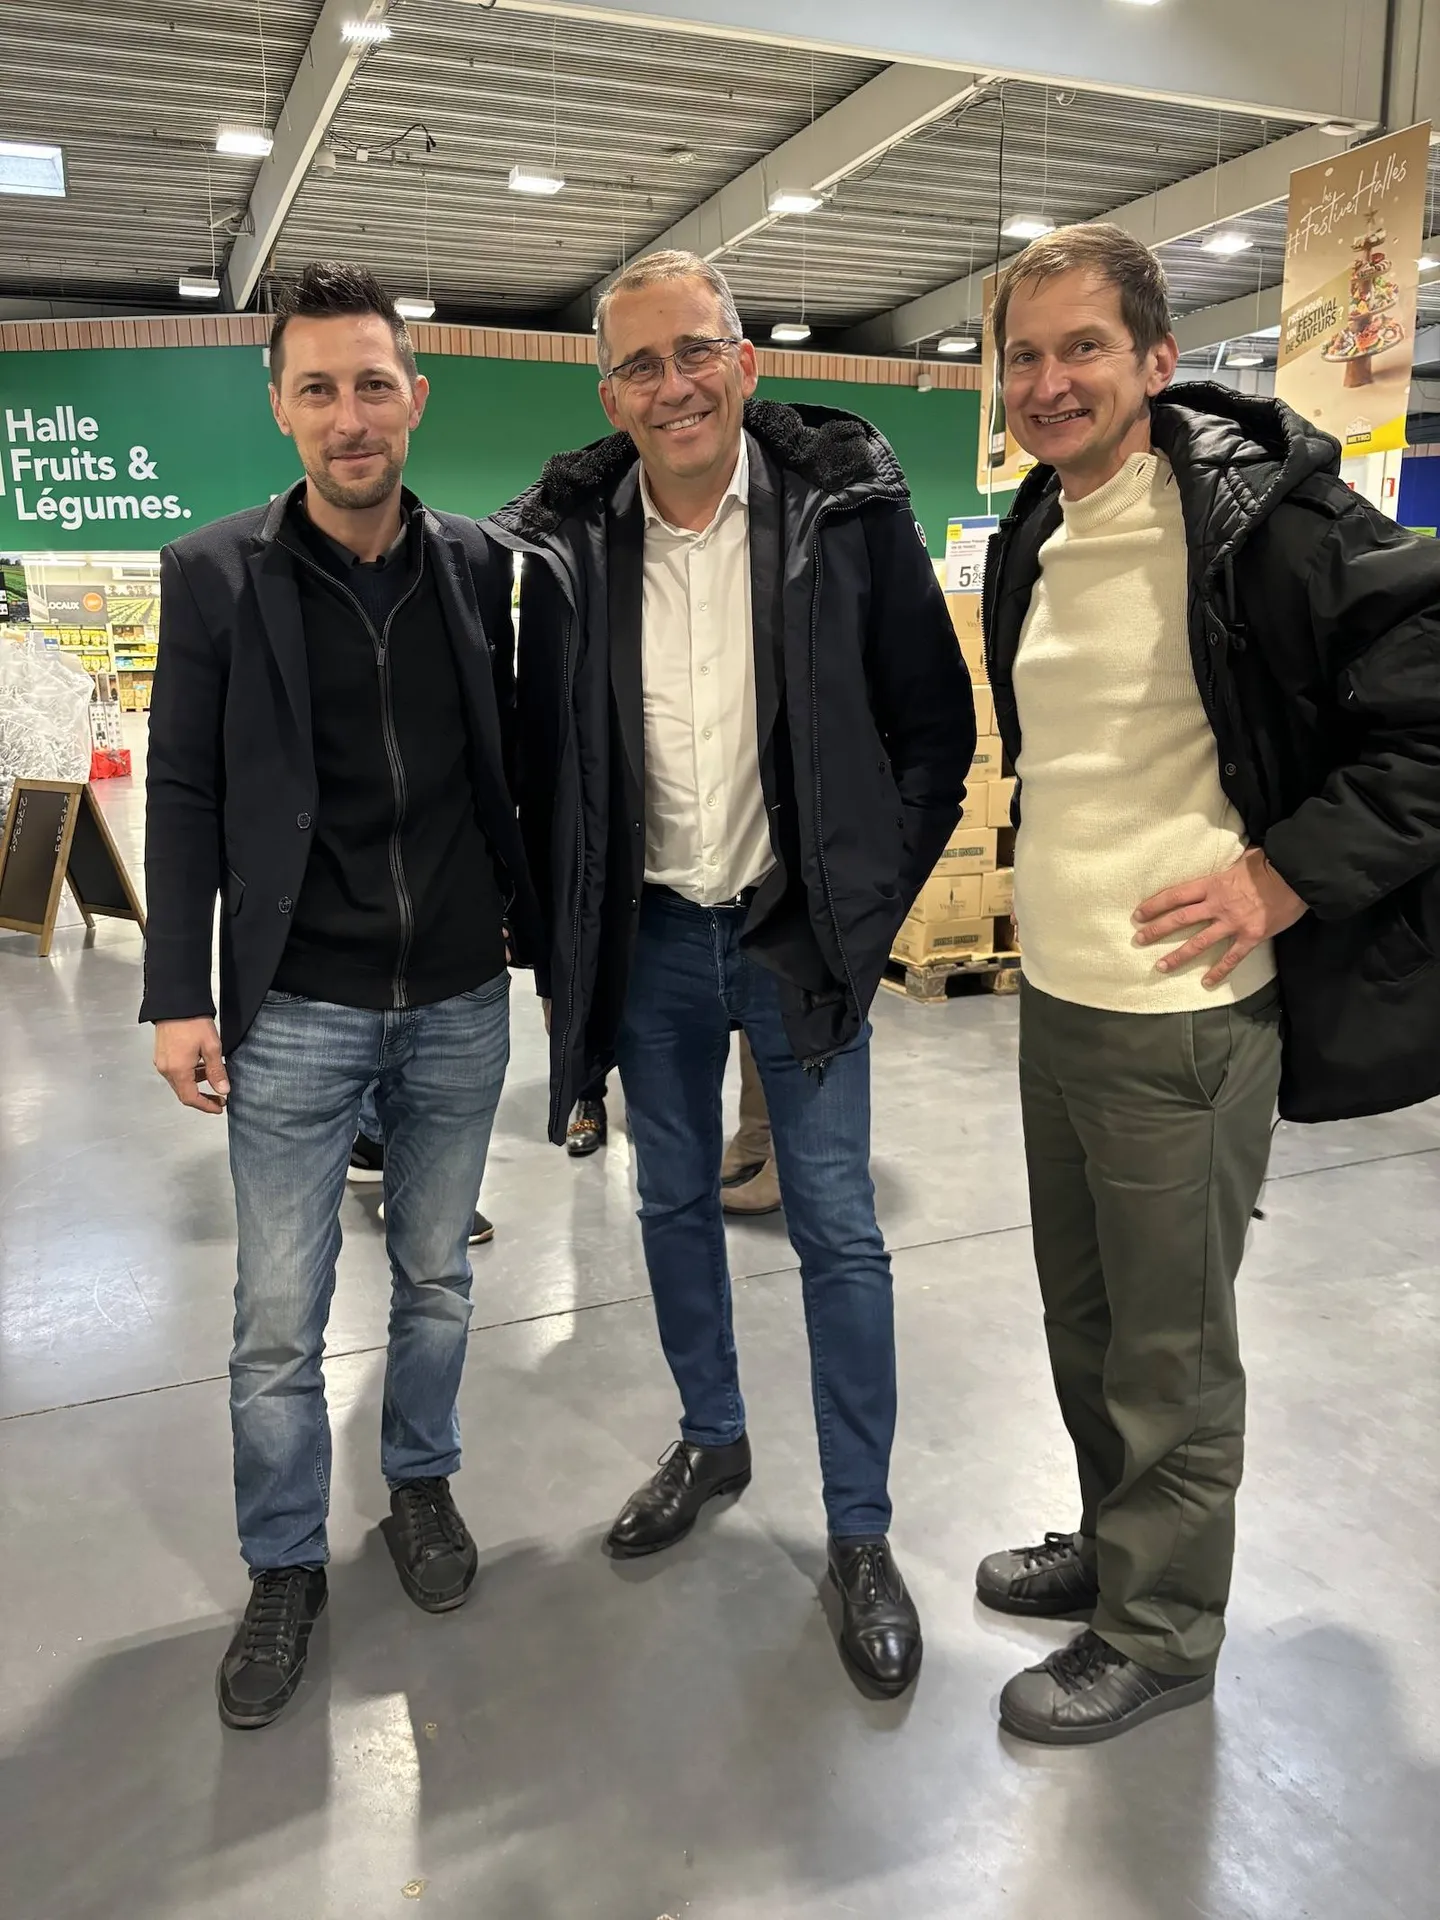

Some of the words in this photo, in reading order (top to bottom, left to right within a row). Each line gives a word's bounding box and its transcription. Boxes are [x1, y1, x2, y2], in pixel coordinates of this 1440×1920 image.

[1285, 340, 1295, 355] DE
[1295, 310, 1337, 349] SAVEURS
[1286, 326, 1297, 341] UN
[1295, 297, 1338, 334] FESTIVAL
[5, 405, 99, 442] Halle
[10, 447, 117, 482] Fruits
[128, 445, 159, 481] &
[15, 487, 192, 531] Légumes.
[959, 566, 971, 588] 5
